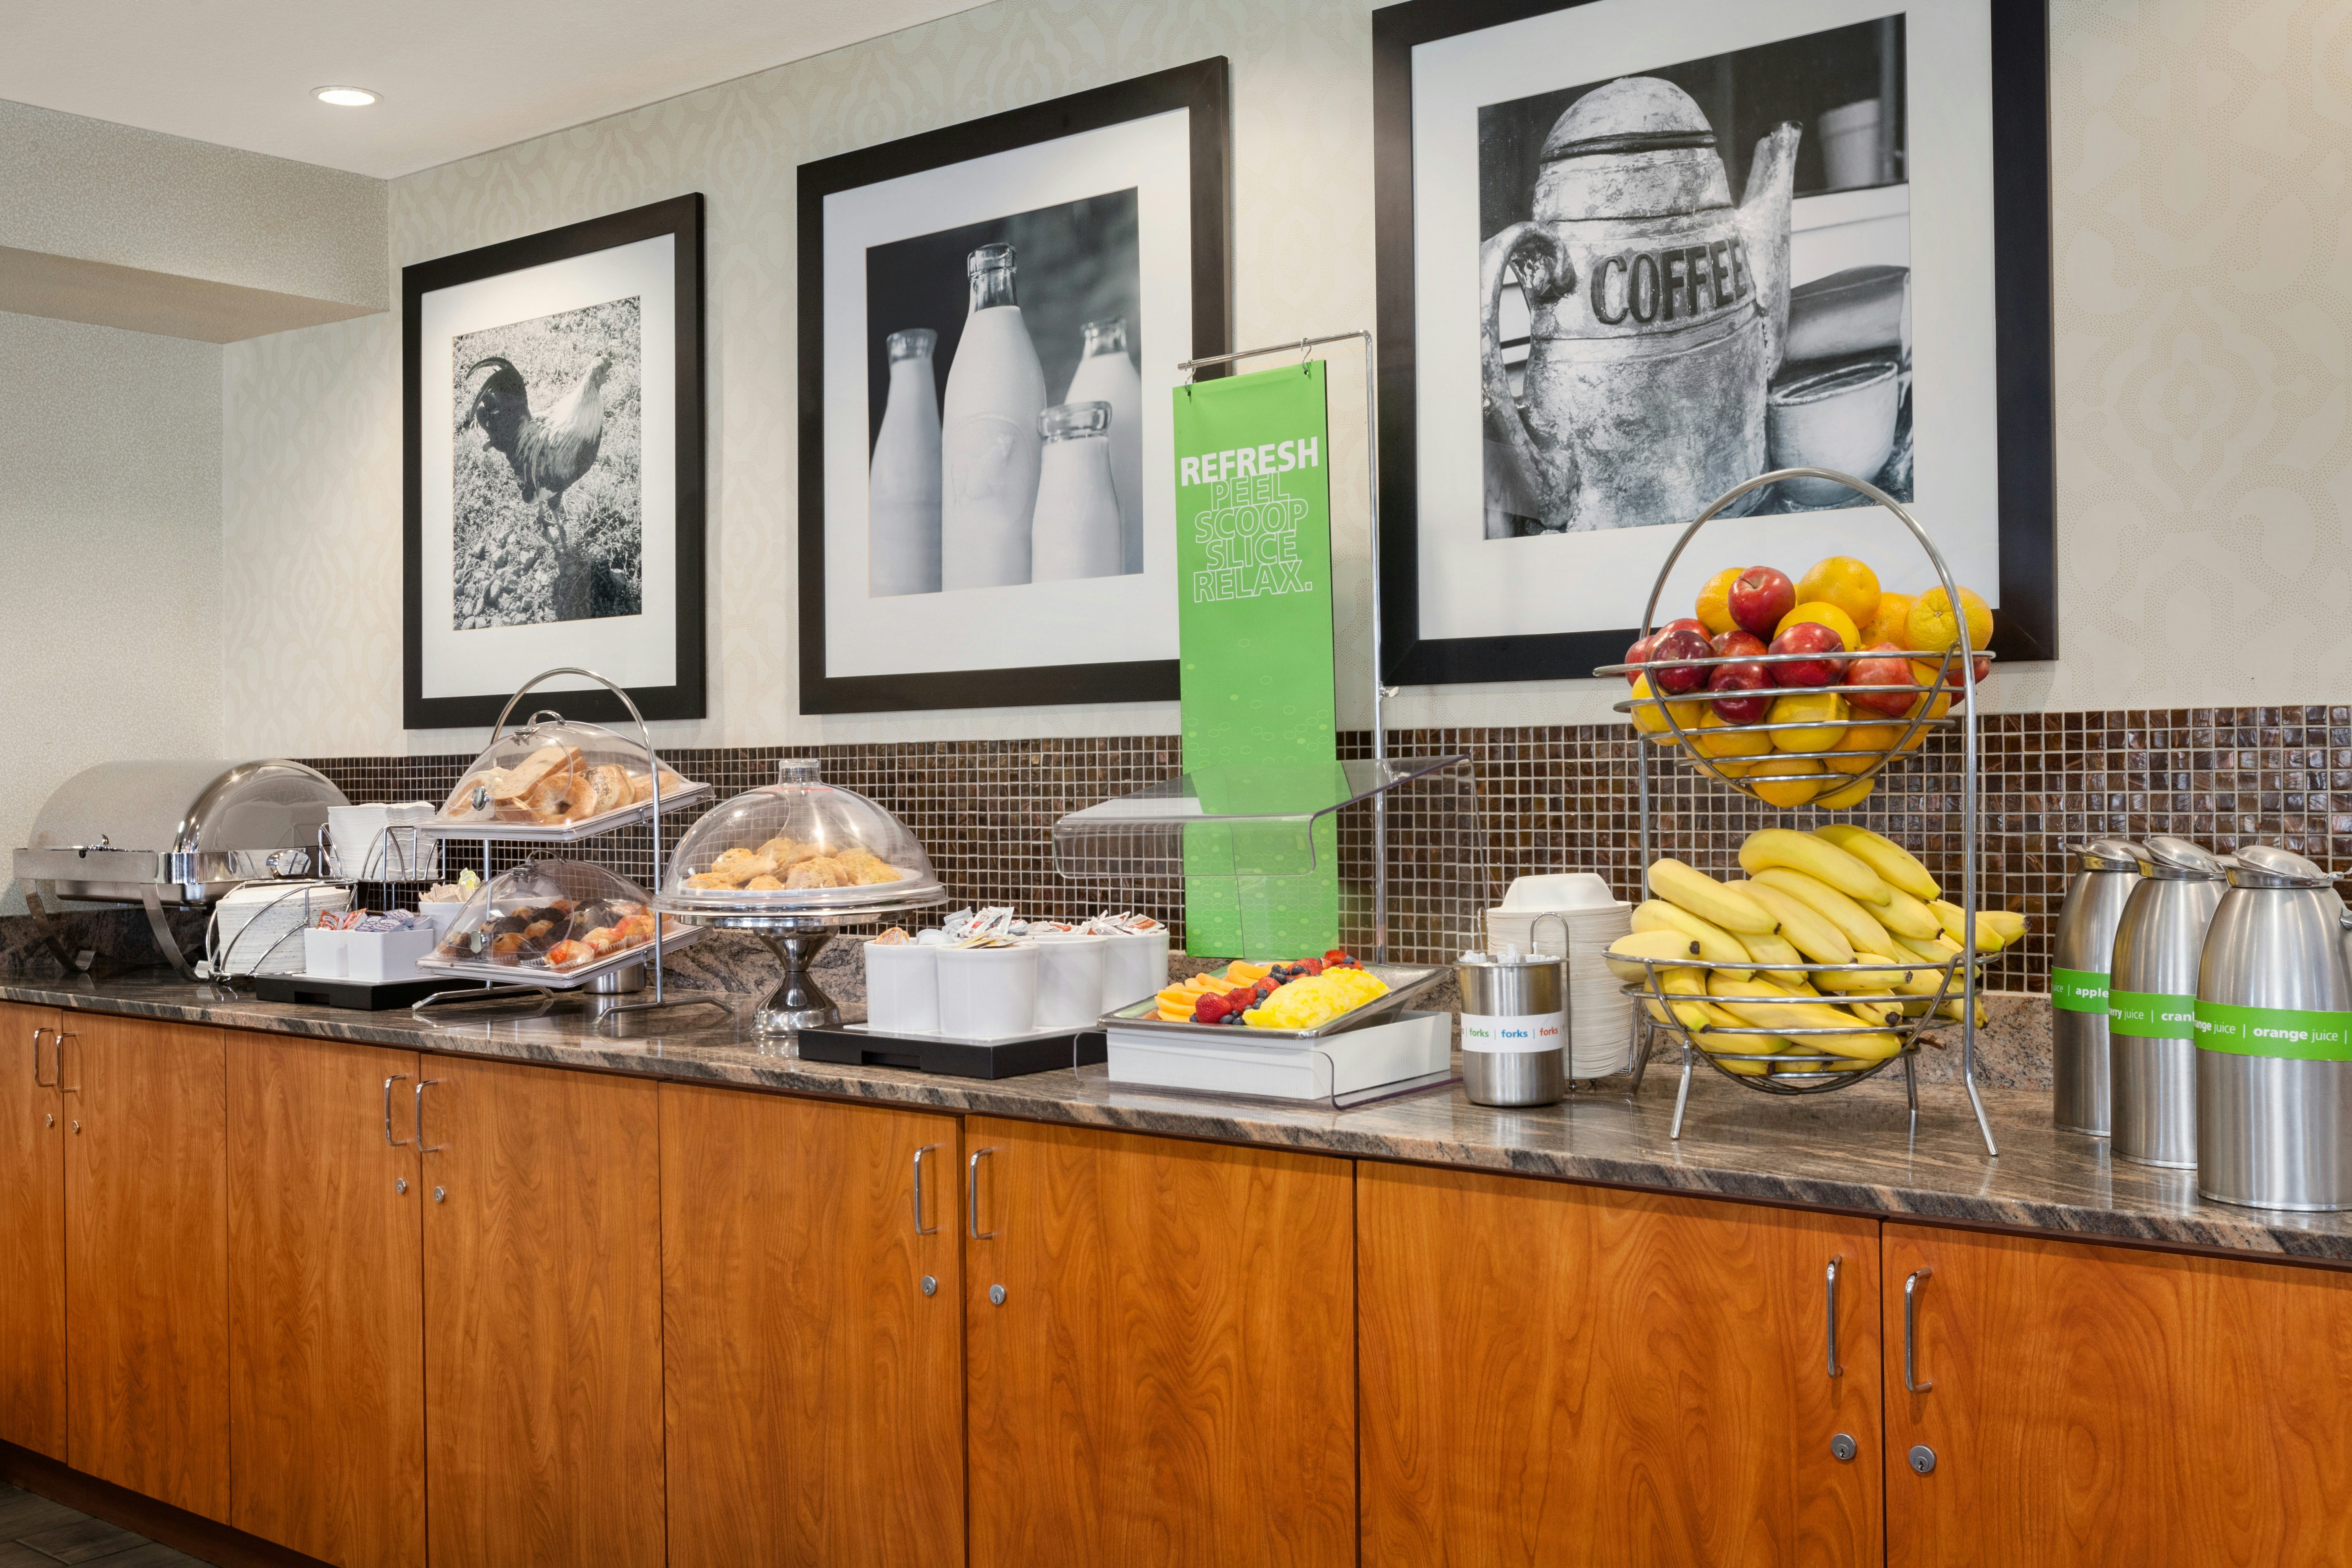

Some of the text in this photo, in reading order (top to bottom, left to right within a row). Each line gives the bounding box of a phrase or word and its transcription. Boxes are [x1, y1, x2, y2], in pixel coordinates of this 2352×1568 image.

[1591, 239, 1748, 325] COFFEE
[1180, 436, 1318, 486] REFRESH
[1211, 471, 1290, 511] PEEL
[1195, 499, 1308, 543] SCOOP
[1206, 530, 1298, 571] SLICE
[1193, 560, 1312, 603] RELAX.
[2076, 987, 2109, 998] apple
[1470, 1028, 1489, 1037] forks
[1501, 1029, 1528, 1038] forks
[1540, 1027, 1558, 1036] forks
[2124, 1008, 2144, 1020] juice
[2213, 1021, 2236, 1034] juice
[2253, 1028, 2308, 1042] orange
[2311, 1029, 2338, 1043] juice
